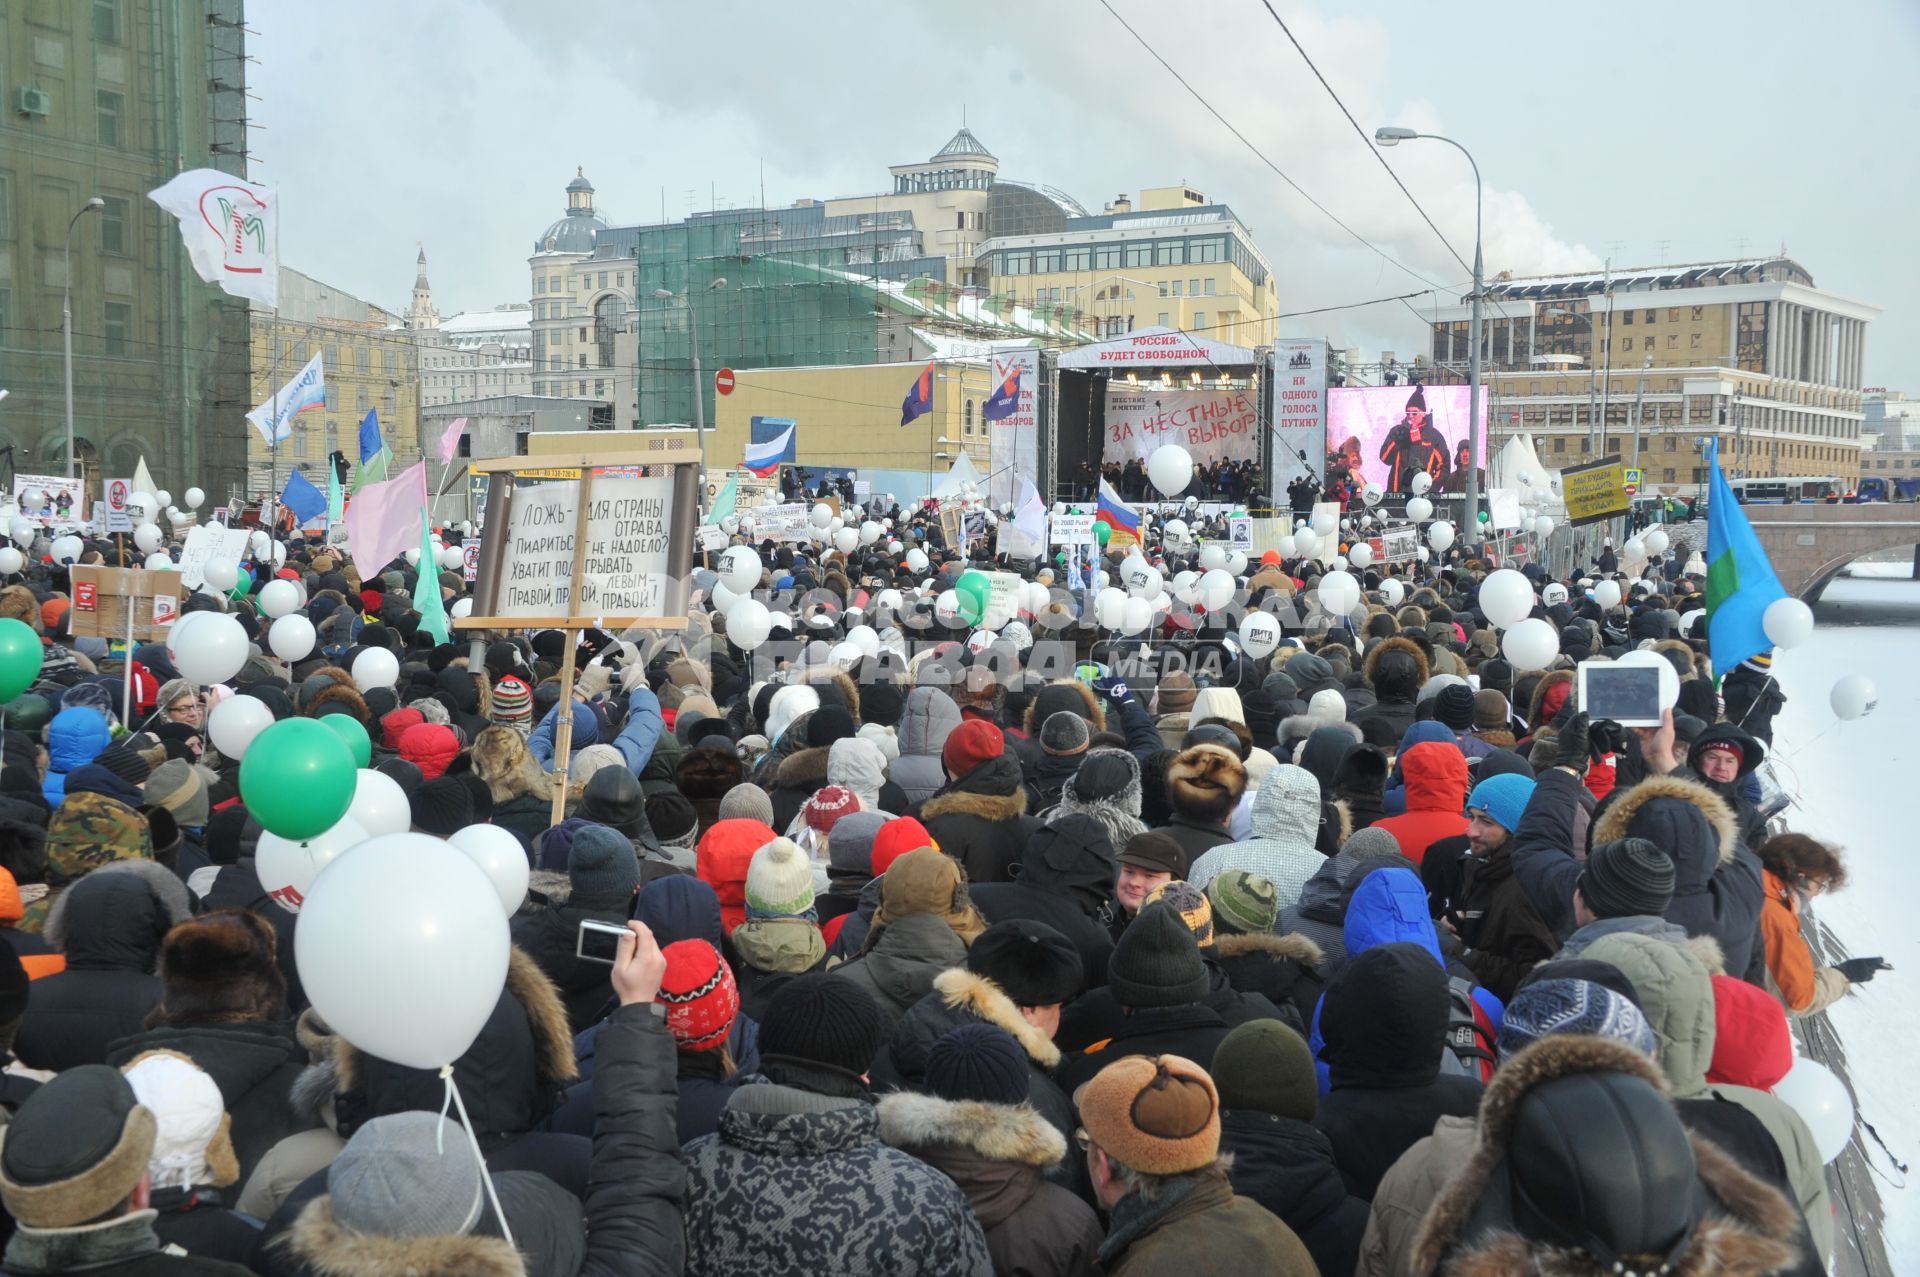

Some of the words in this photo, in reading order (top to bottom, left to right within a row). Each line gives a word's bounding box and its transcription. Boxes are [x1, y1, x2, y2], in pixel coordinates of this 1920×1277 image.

[1100, 351, 1136, 361] БУДЕТ
[1137, 347, 1210, 361] СВОБОДНОЙ!
[1292, 376, 1306, 386] НИ
[1282, 390, 1318, 401] ОДНОГО
[1282, 404, 1318, 414] ГОЛОСА
[1108, 421, 1134, 443] ЗА
[1142, 394, 1248, 434] ЧЕСТНЫЕ
[1281, 418, 1319, 428] ПУТИНУ
[613, 498, 664, 520] СТРАНЫ
[591, 541, 606, 555] НЕ
[610, 534, 670, 554] НАДОЕЛО?
[510, 560, 551, 580] ХВАТИТ
